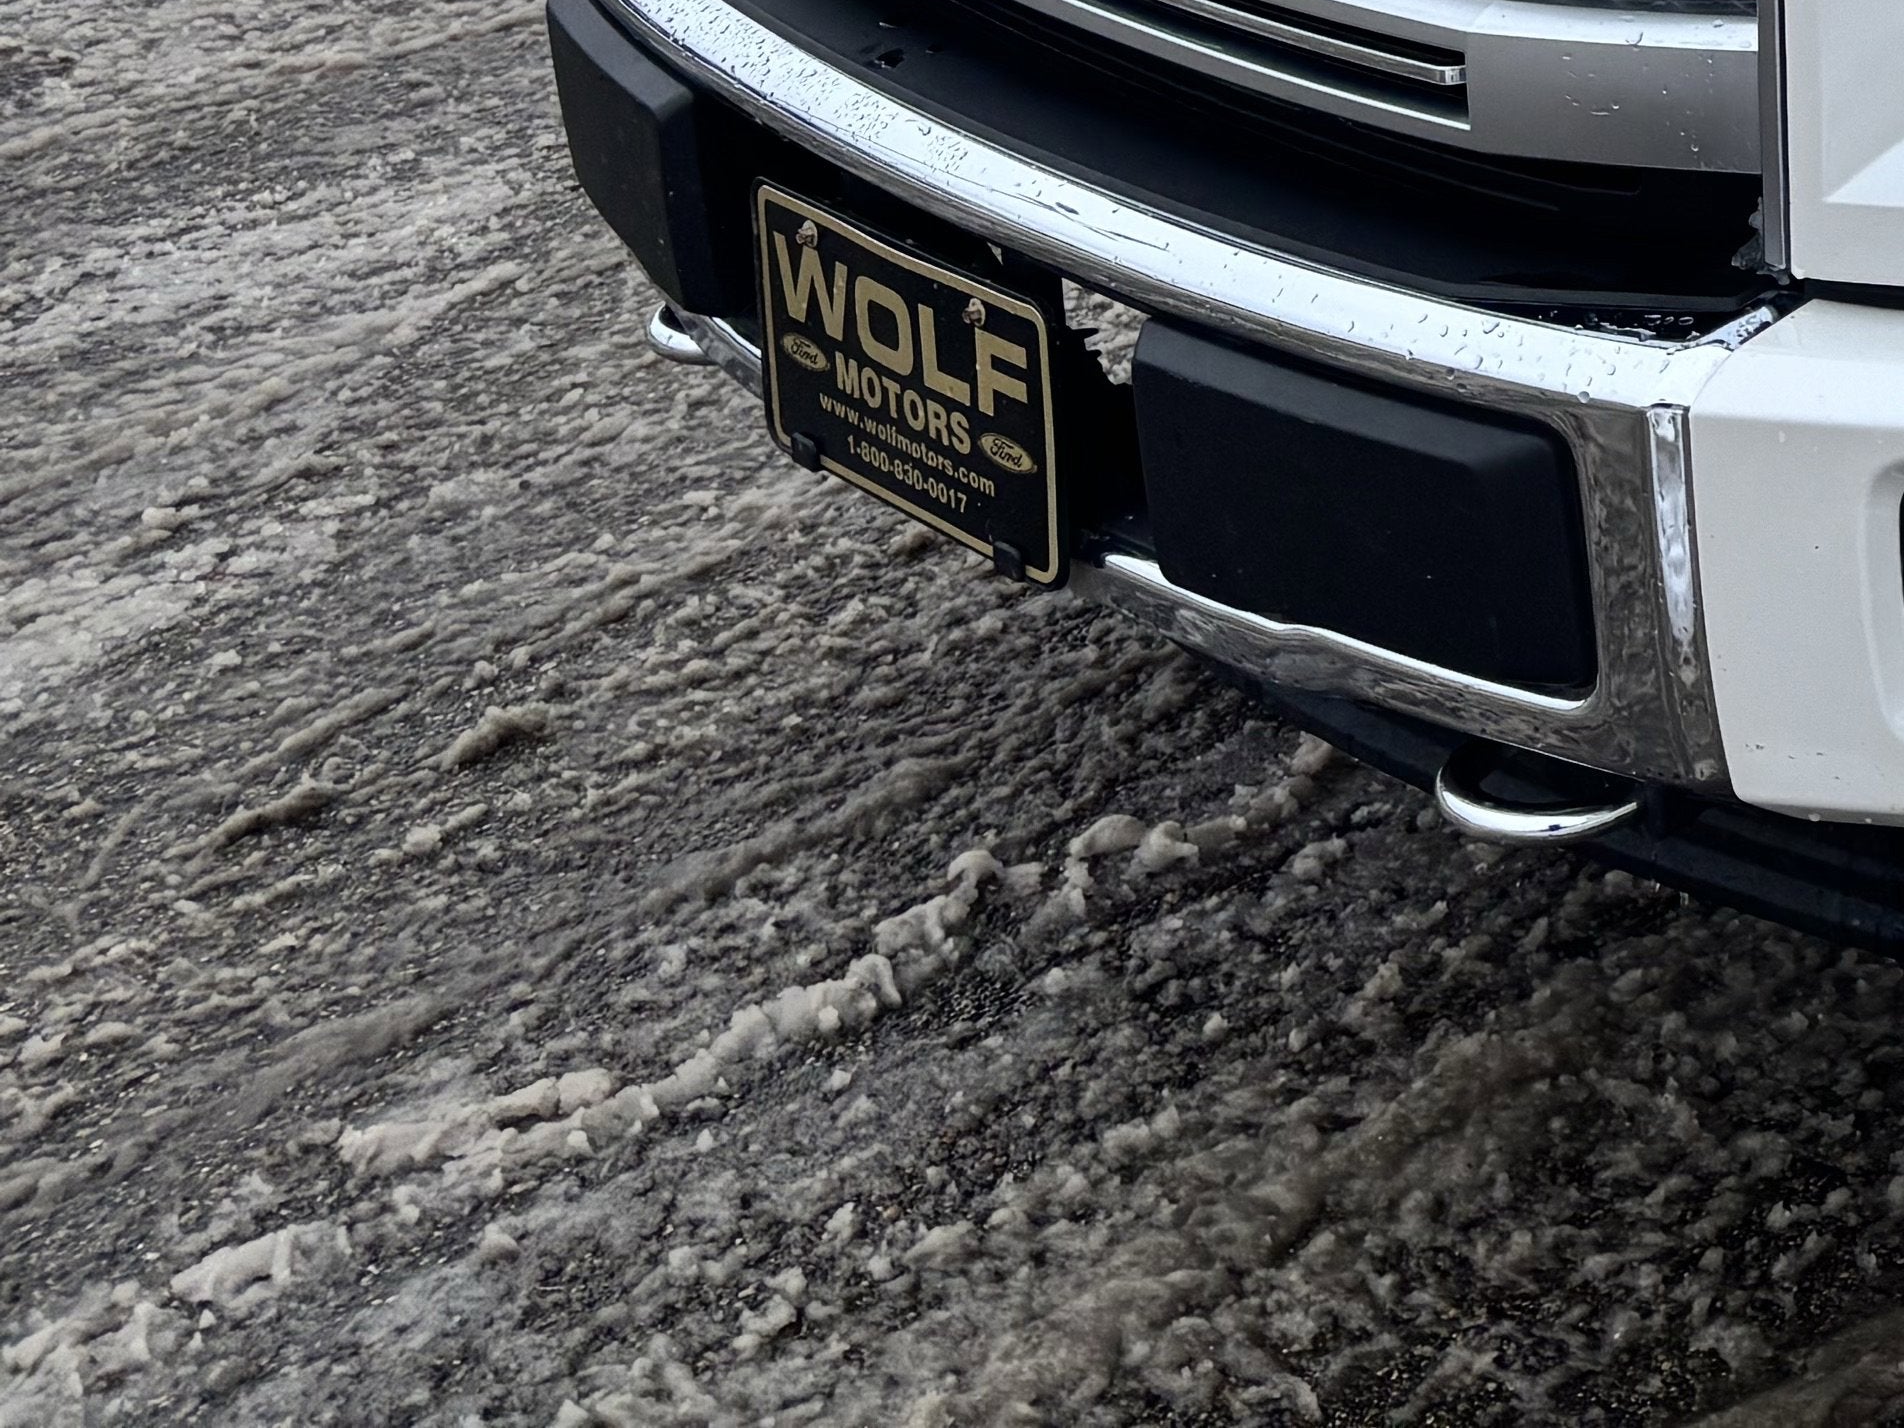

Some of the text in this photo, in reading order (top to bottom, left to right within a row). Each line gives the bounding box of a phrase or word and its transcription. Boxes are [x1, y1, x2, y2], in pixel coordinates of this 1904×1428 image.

[773, 231, 1029, 417] WOLF
[790, 338, 819, 365] Ford
[819, 392, 996, 498] www.wolfmotors.com
[835, 350, 972, 455] MOTORS
[847, 434, 968, 514] 1-800-830-0017
[990, 438, 1023, 468] Ford
